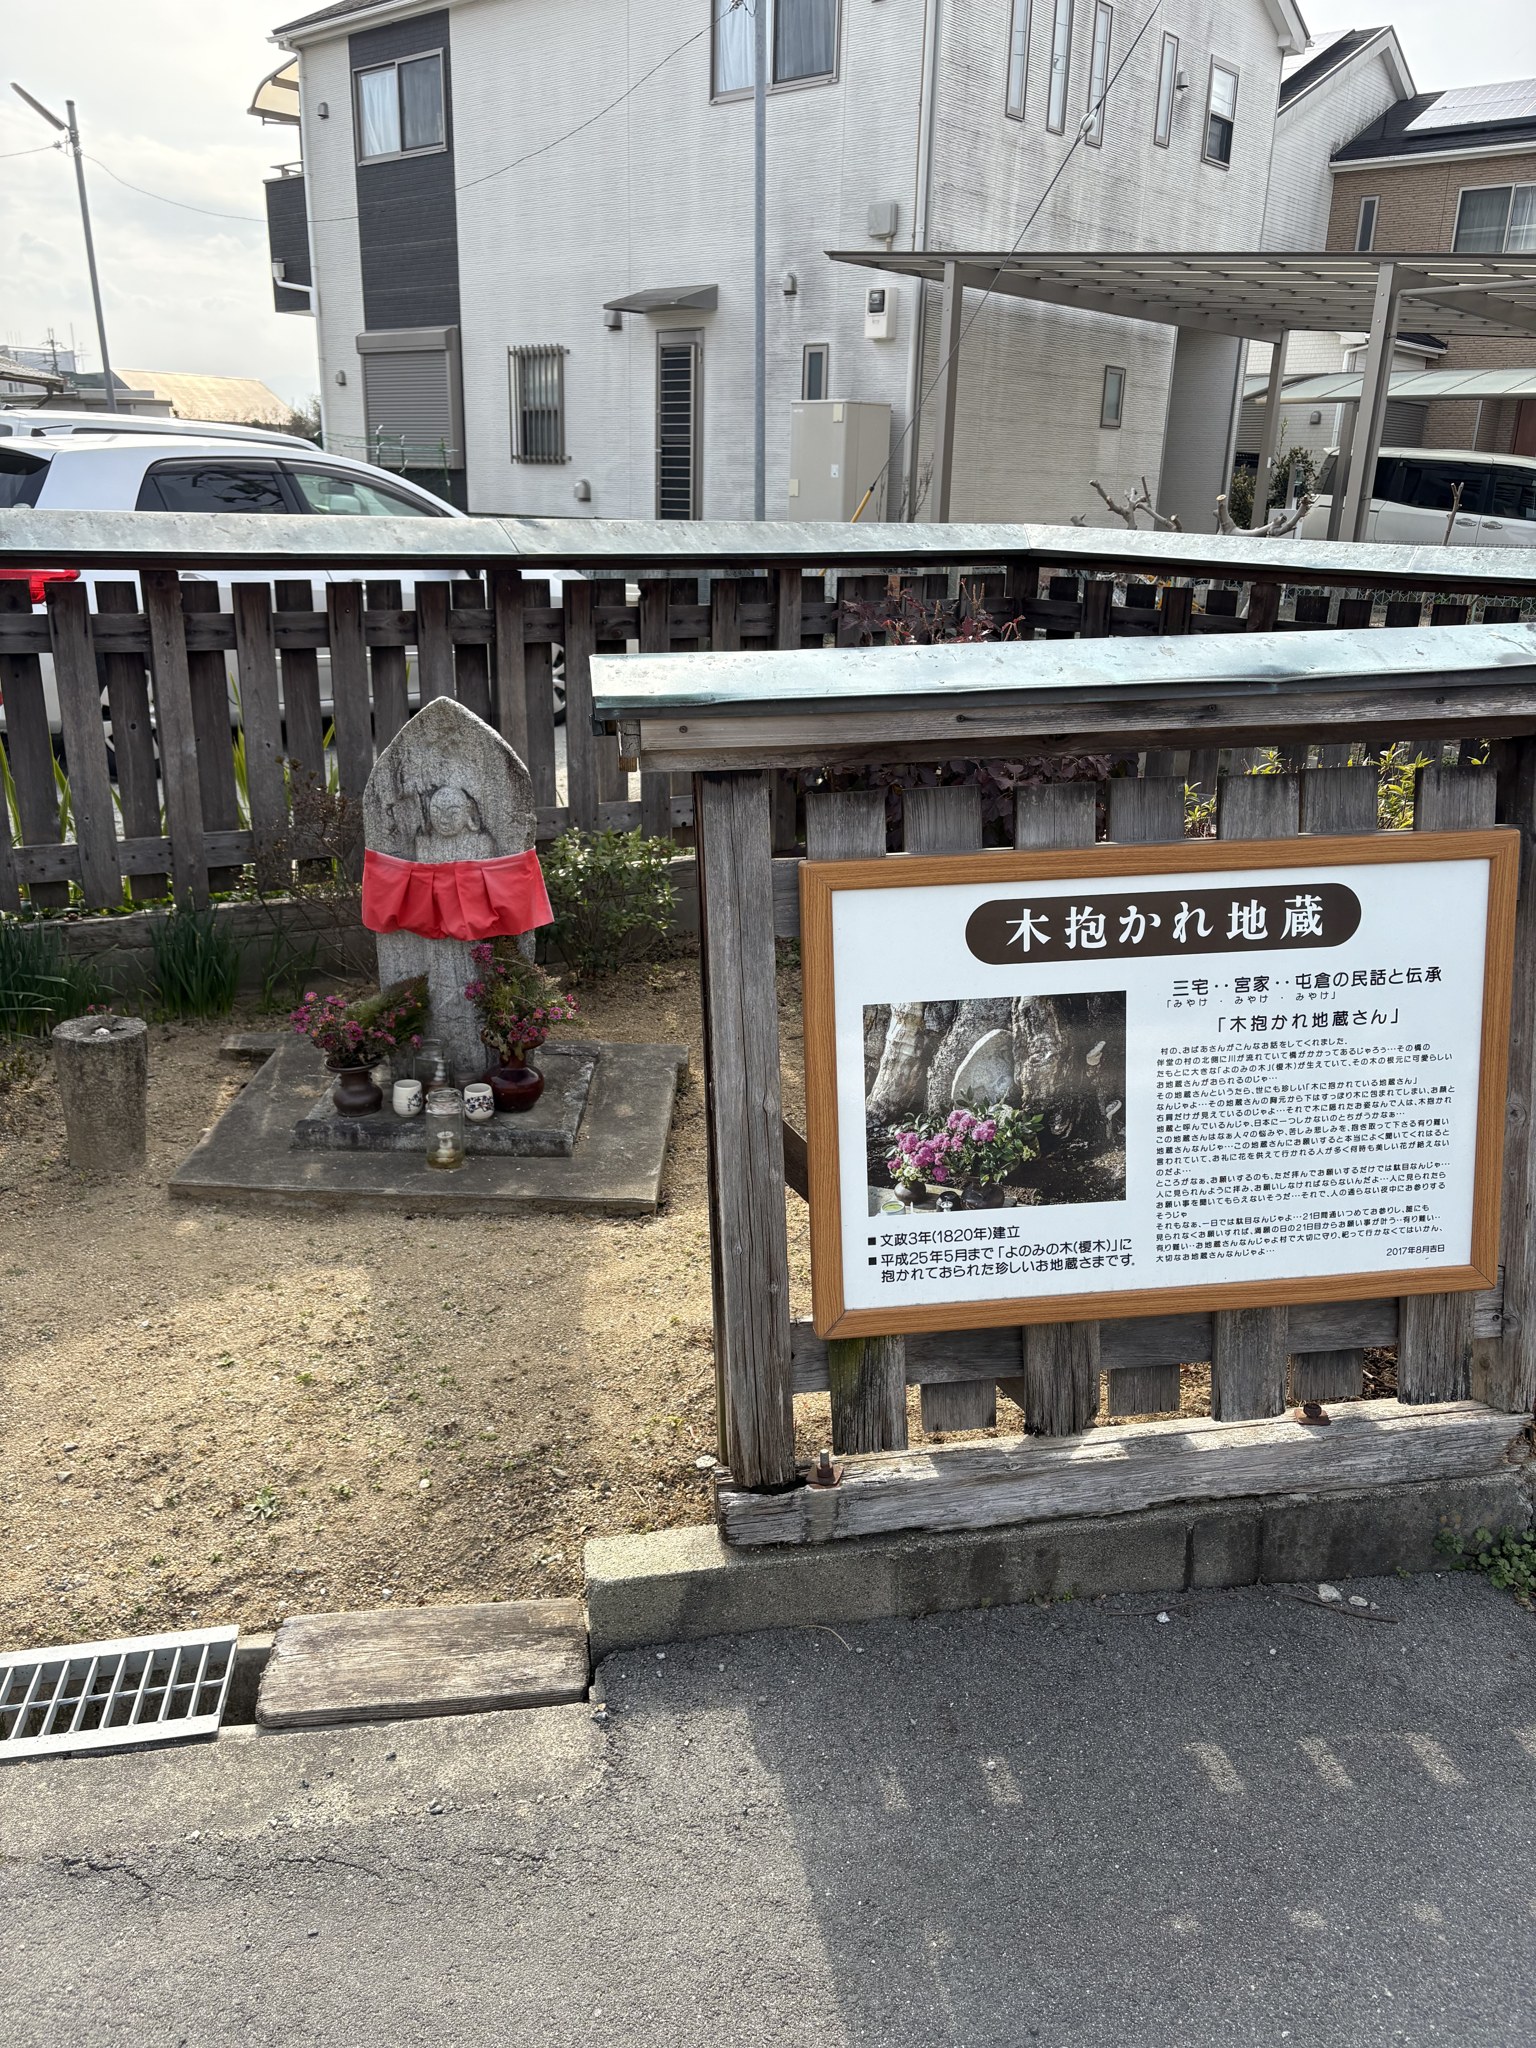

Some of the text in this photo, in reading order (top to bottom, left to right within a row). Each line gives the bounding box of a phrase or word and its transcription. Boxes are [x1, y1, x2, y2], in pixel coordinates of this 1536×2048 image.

[1005, 894, 1324, 952] 木抱かれ地蔵
[1218, 1008, 1398, 1032] 「木抱かれ地蔵さん」
[1156, 1211, 1187, 1219] そうじゃ
[881, 1225, 1020, 1246] 文政3年(1820年)建立
[1386, 1244, 1445, 1256] 2017年8月吉日
